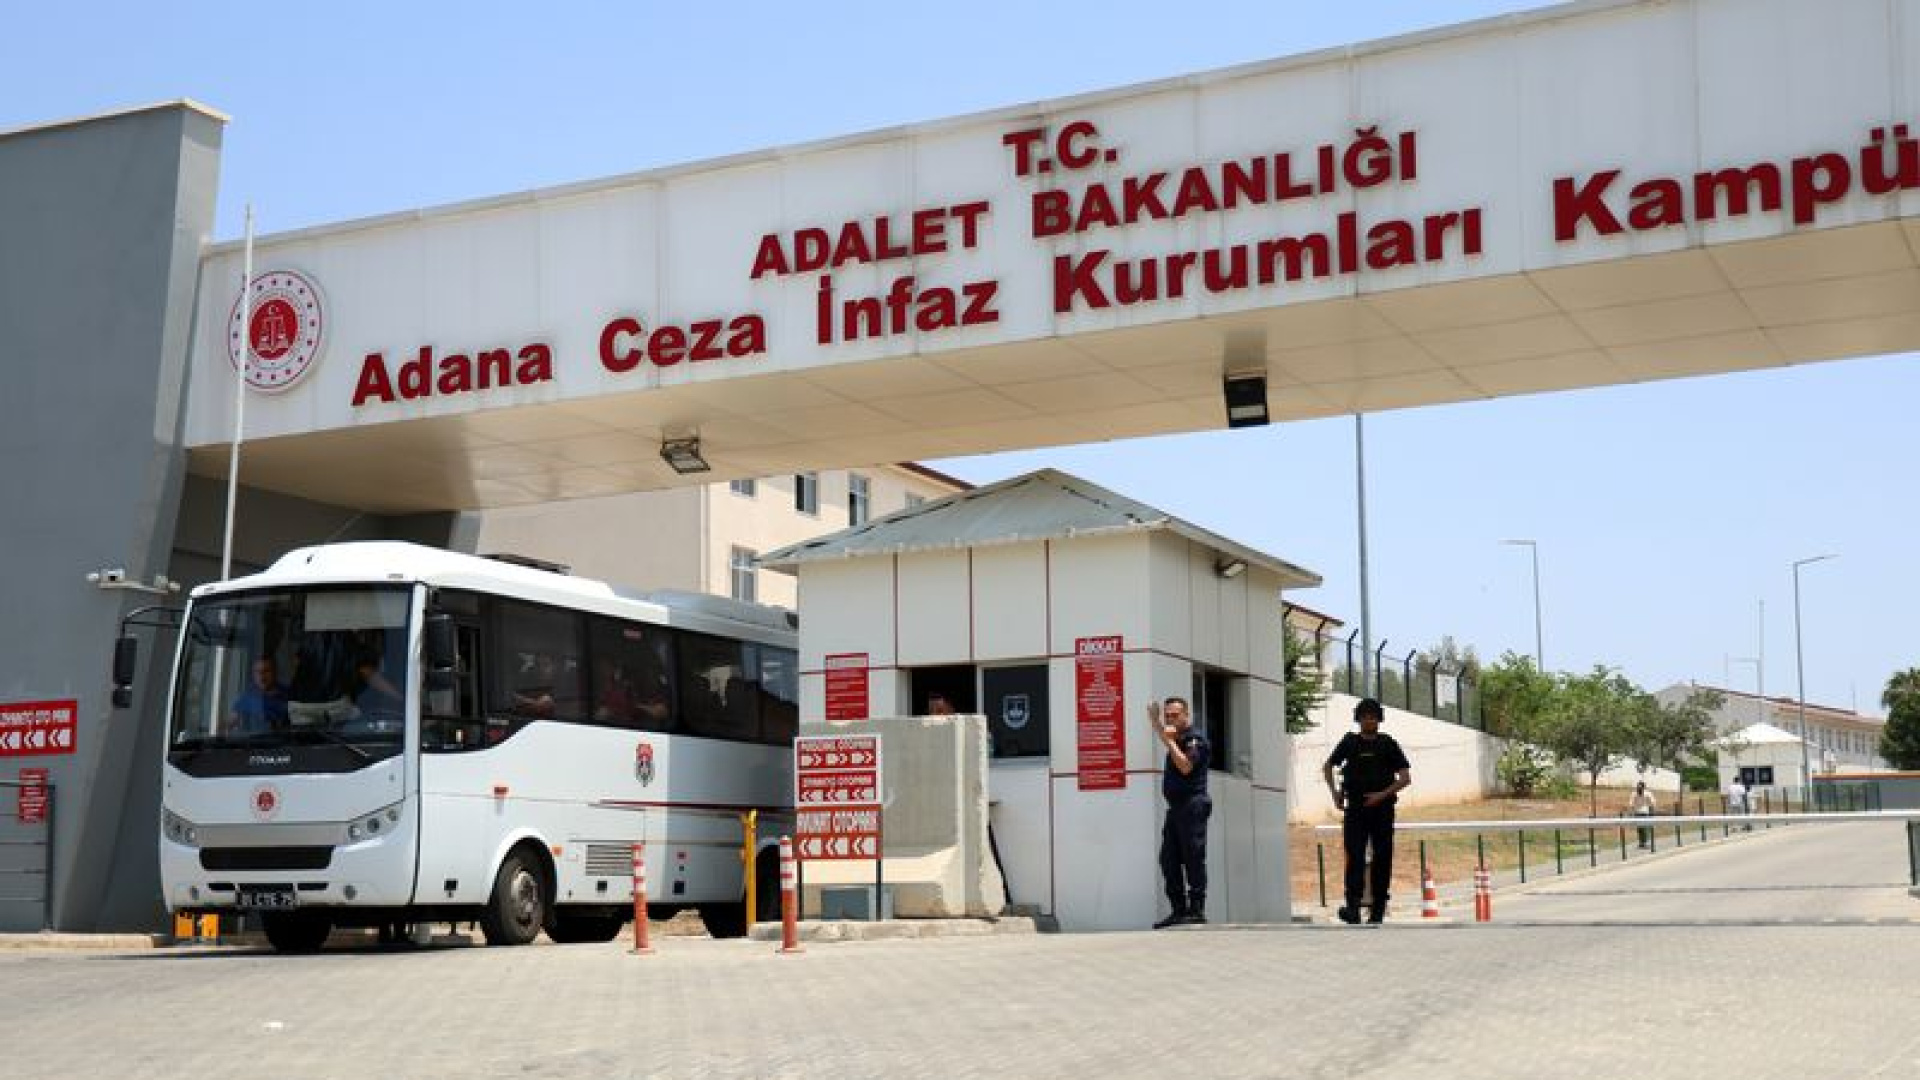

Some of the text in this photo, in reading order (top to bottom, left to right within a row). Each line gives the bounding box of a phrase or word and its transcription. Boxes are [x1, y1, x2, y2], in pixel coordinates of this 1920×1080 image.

[751, 126, 1417, 279] ADALET BAKANLIĞI
[1003, 120, 1119, 177] T.C.
[352, 343, 551, 406] Adana
[599, 316, 766, 373] Ceza
[818, 275, 999, 344] İnfaz
[1055, 208, 1482, 313] Kurumları
